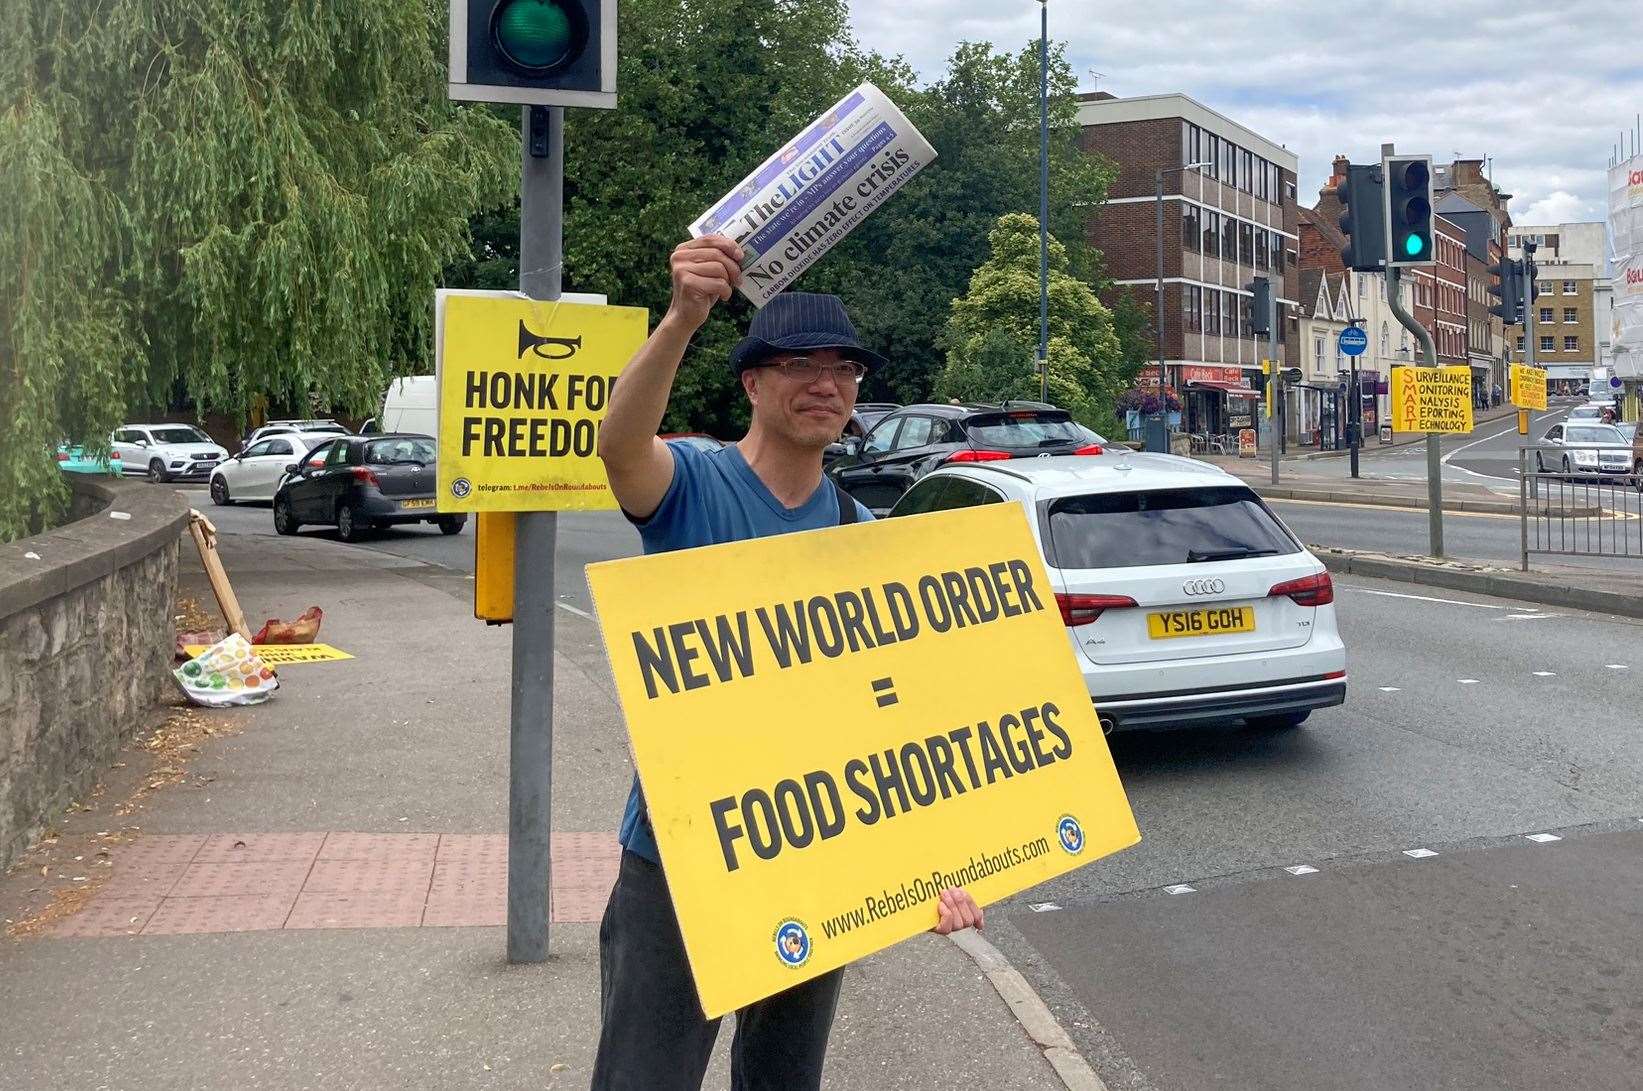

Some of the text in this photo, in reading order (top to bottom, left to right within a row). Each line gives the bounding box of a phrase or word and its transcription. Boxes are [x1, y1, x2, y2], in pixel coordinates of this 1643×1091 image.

[820, 161, 845, 185] answer
[841, 150, 859, 167] your
[854, 124, 887, 154] questions
[747, 257, 785, 290] No
[784, 193, 857, 262] climate
[856, 147, 910, 198] crisis
[761, 275, 788, 300] CARBON
[786, 252, 813, 278] DIOXIDE
[811, 241, 826, 256] HAS
[824, 227, 843, 245] ZERO
[841, 209, 864, 231] EFFECT
[871, 159, 920, 204] TEMPERATURES
[465, 370, 560, 411] HONK
[462, 416, 604, 458] FREEDO
[478, 484, 513, 493] telegram:
[632, 559, 1044, 699] NEW WORLD ORDER
[1160, 607, 1245, 632] YS16 GOH
[871, 677, 899, 708] =
[709, 701, 1073, 873] FOOD SHORTAGES
[821, 835, 1051, 940] www.RebelsOnRoundabouts.com
